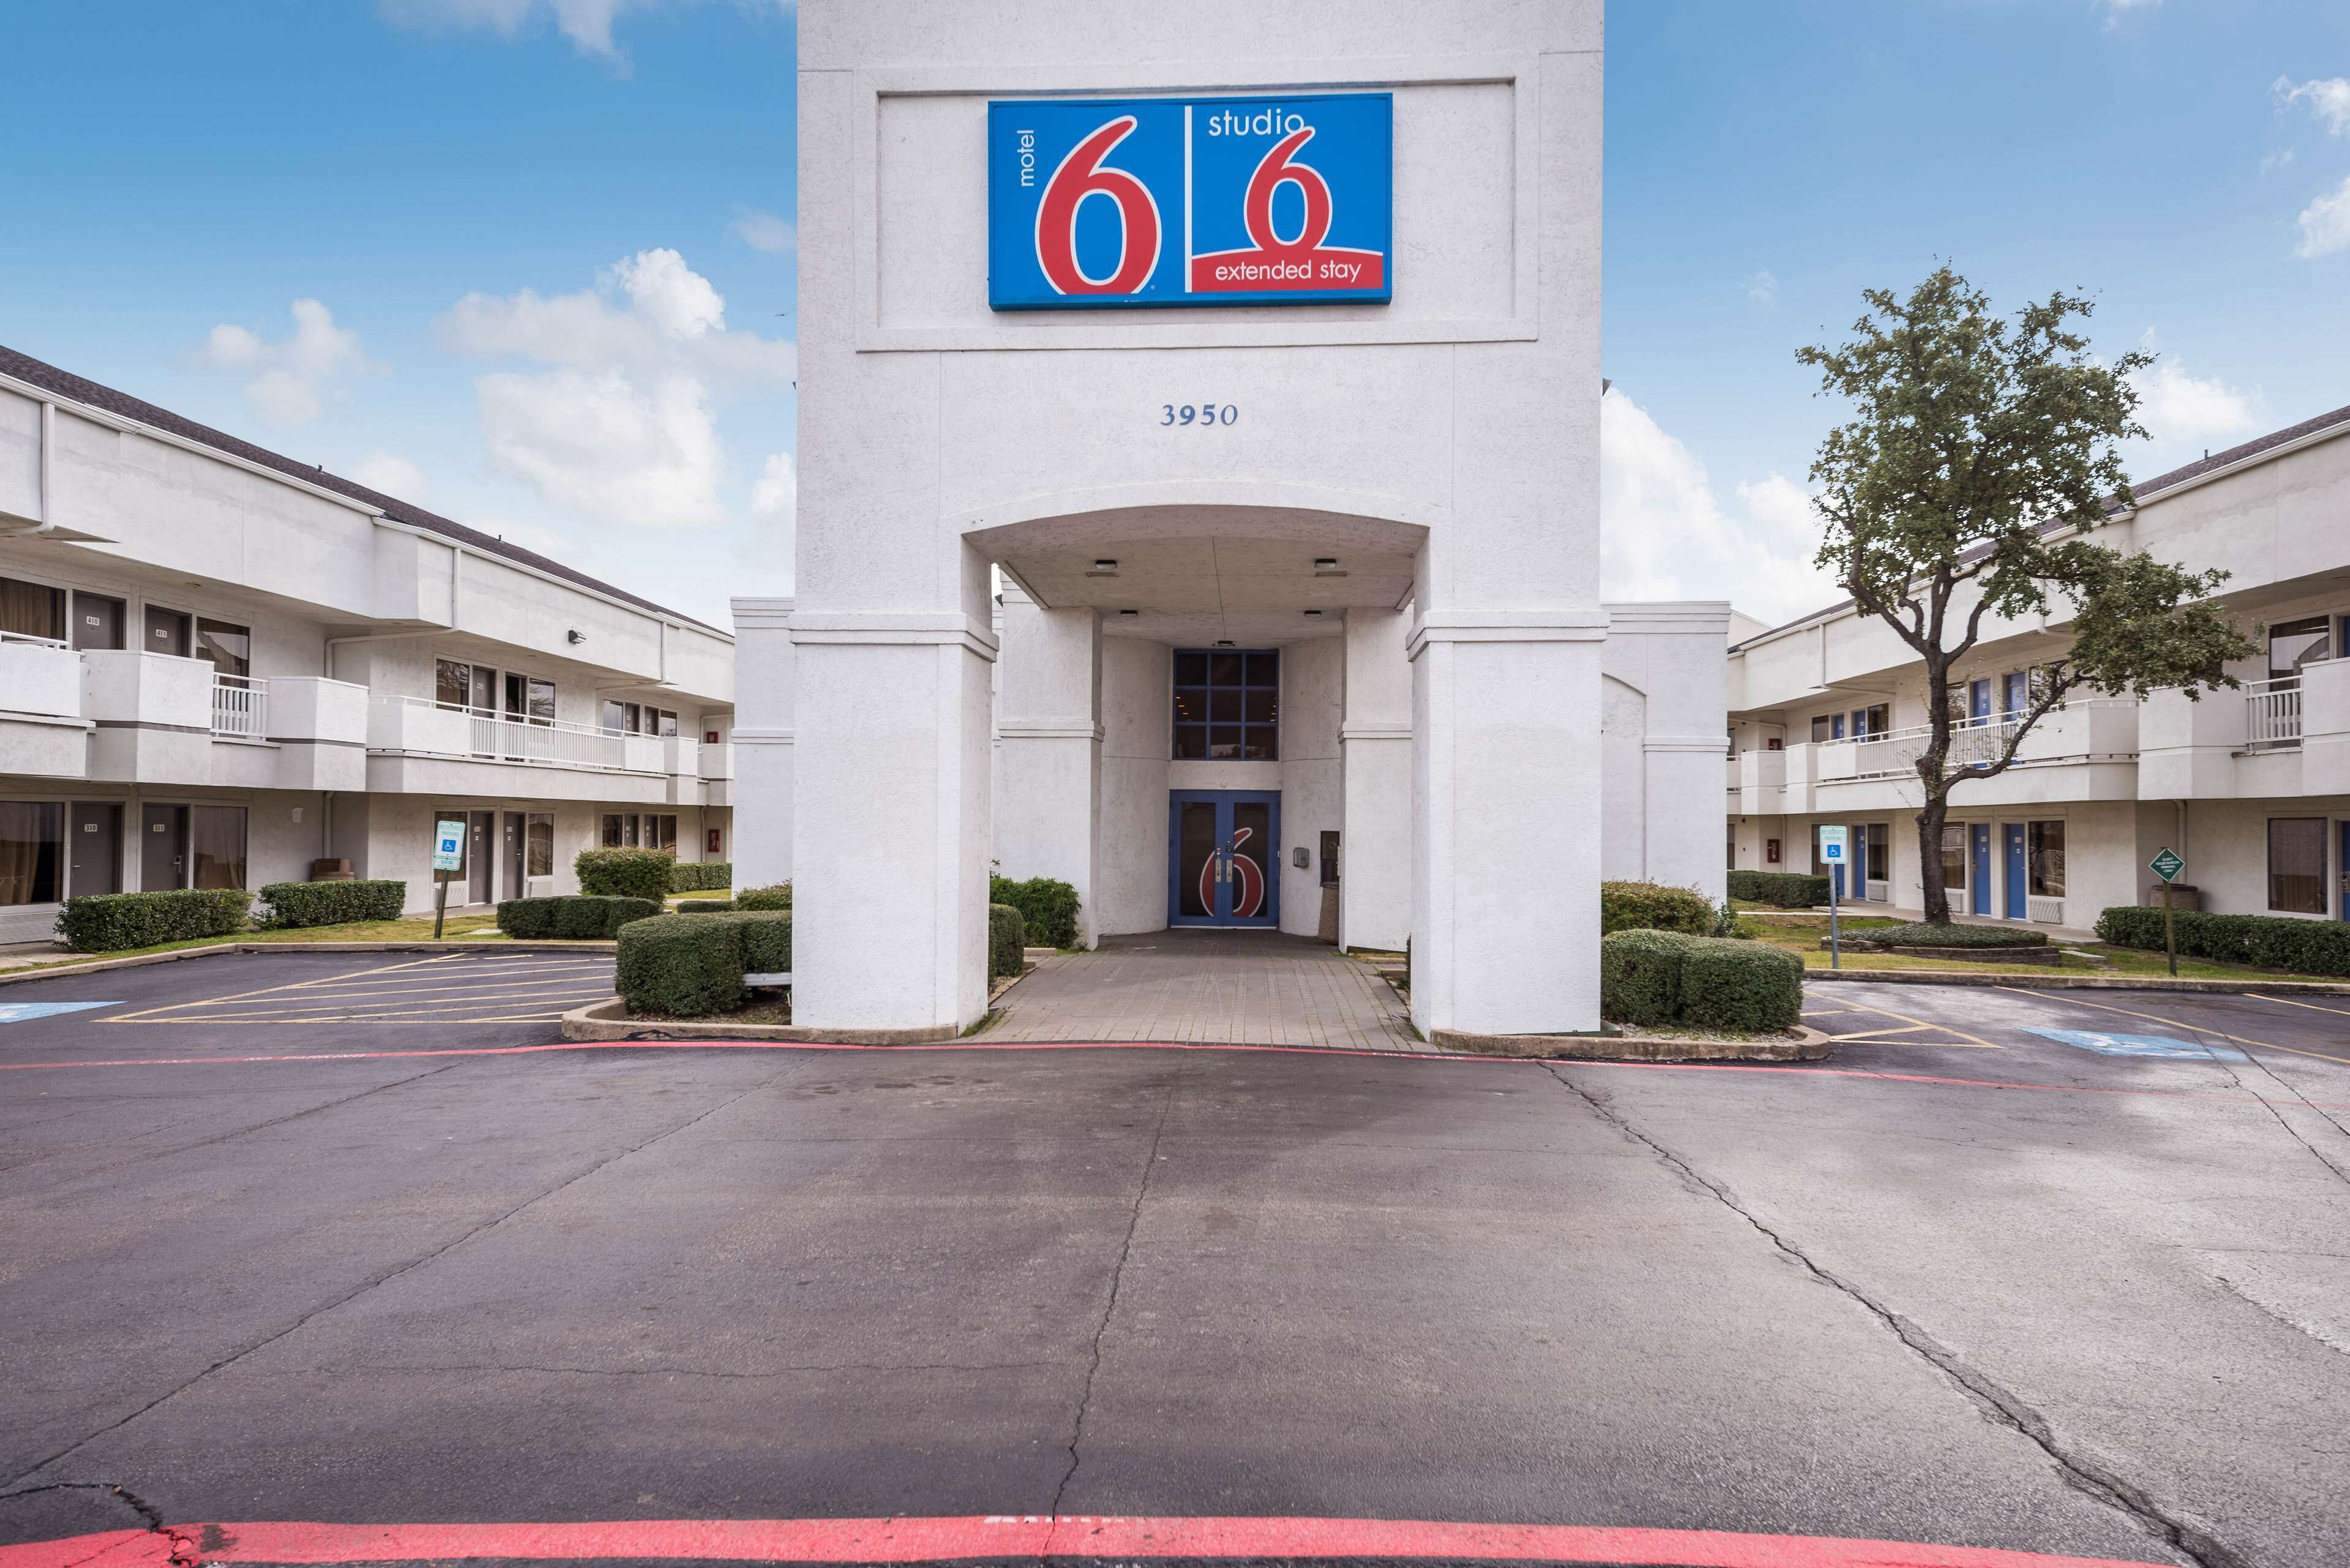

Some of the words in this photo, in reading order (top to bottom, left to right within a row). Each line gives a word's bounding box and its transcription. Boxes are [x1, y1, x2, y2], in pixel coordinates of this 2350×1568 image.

[1208, 108, 1305, 136] studio
[1017, 130, 1035, 187] motel
[1035, 115, 1162, 294] 6
[1243, 125, 1333, 250] 6
[1215, 260, 1312, 280] extended
[1320, 260, 1362, 283] stay
[1160, 403, 1238, 427] 3950
[1199, 827, 1264, 917] 6
